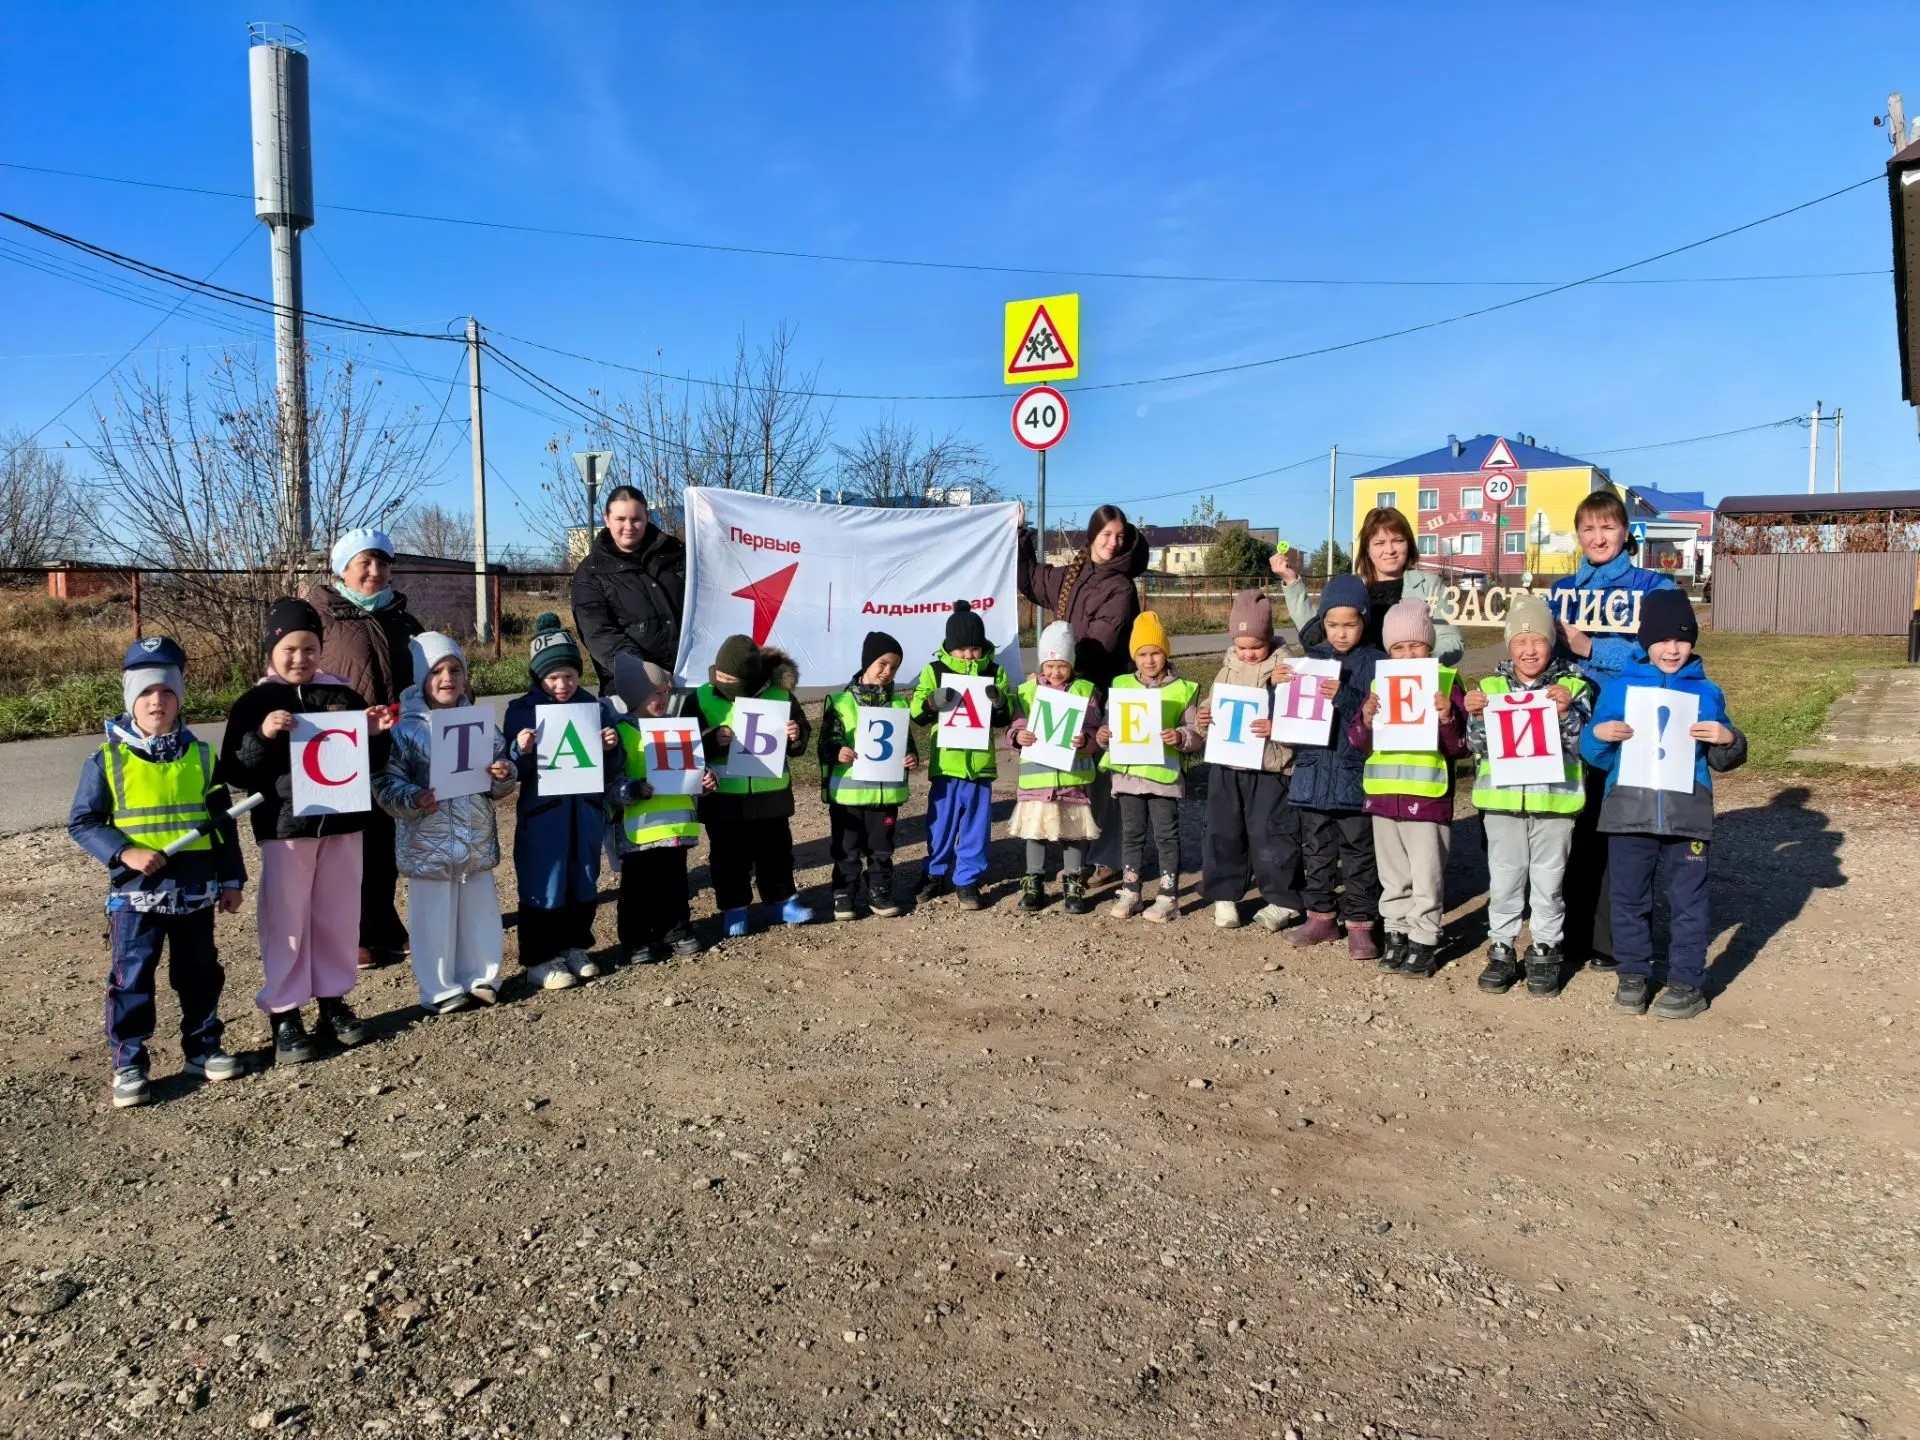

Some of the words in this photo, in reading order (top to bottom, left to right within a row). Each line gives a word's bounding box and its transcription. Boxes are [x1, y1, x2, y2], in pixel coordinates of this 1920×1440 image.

[1024, 404, 1057, 429] 40
[1489, 481, 1508, 493] 20
[730, 526, 801, 554] Первые
